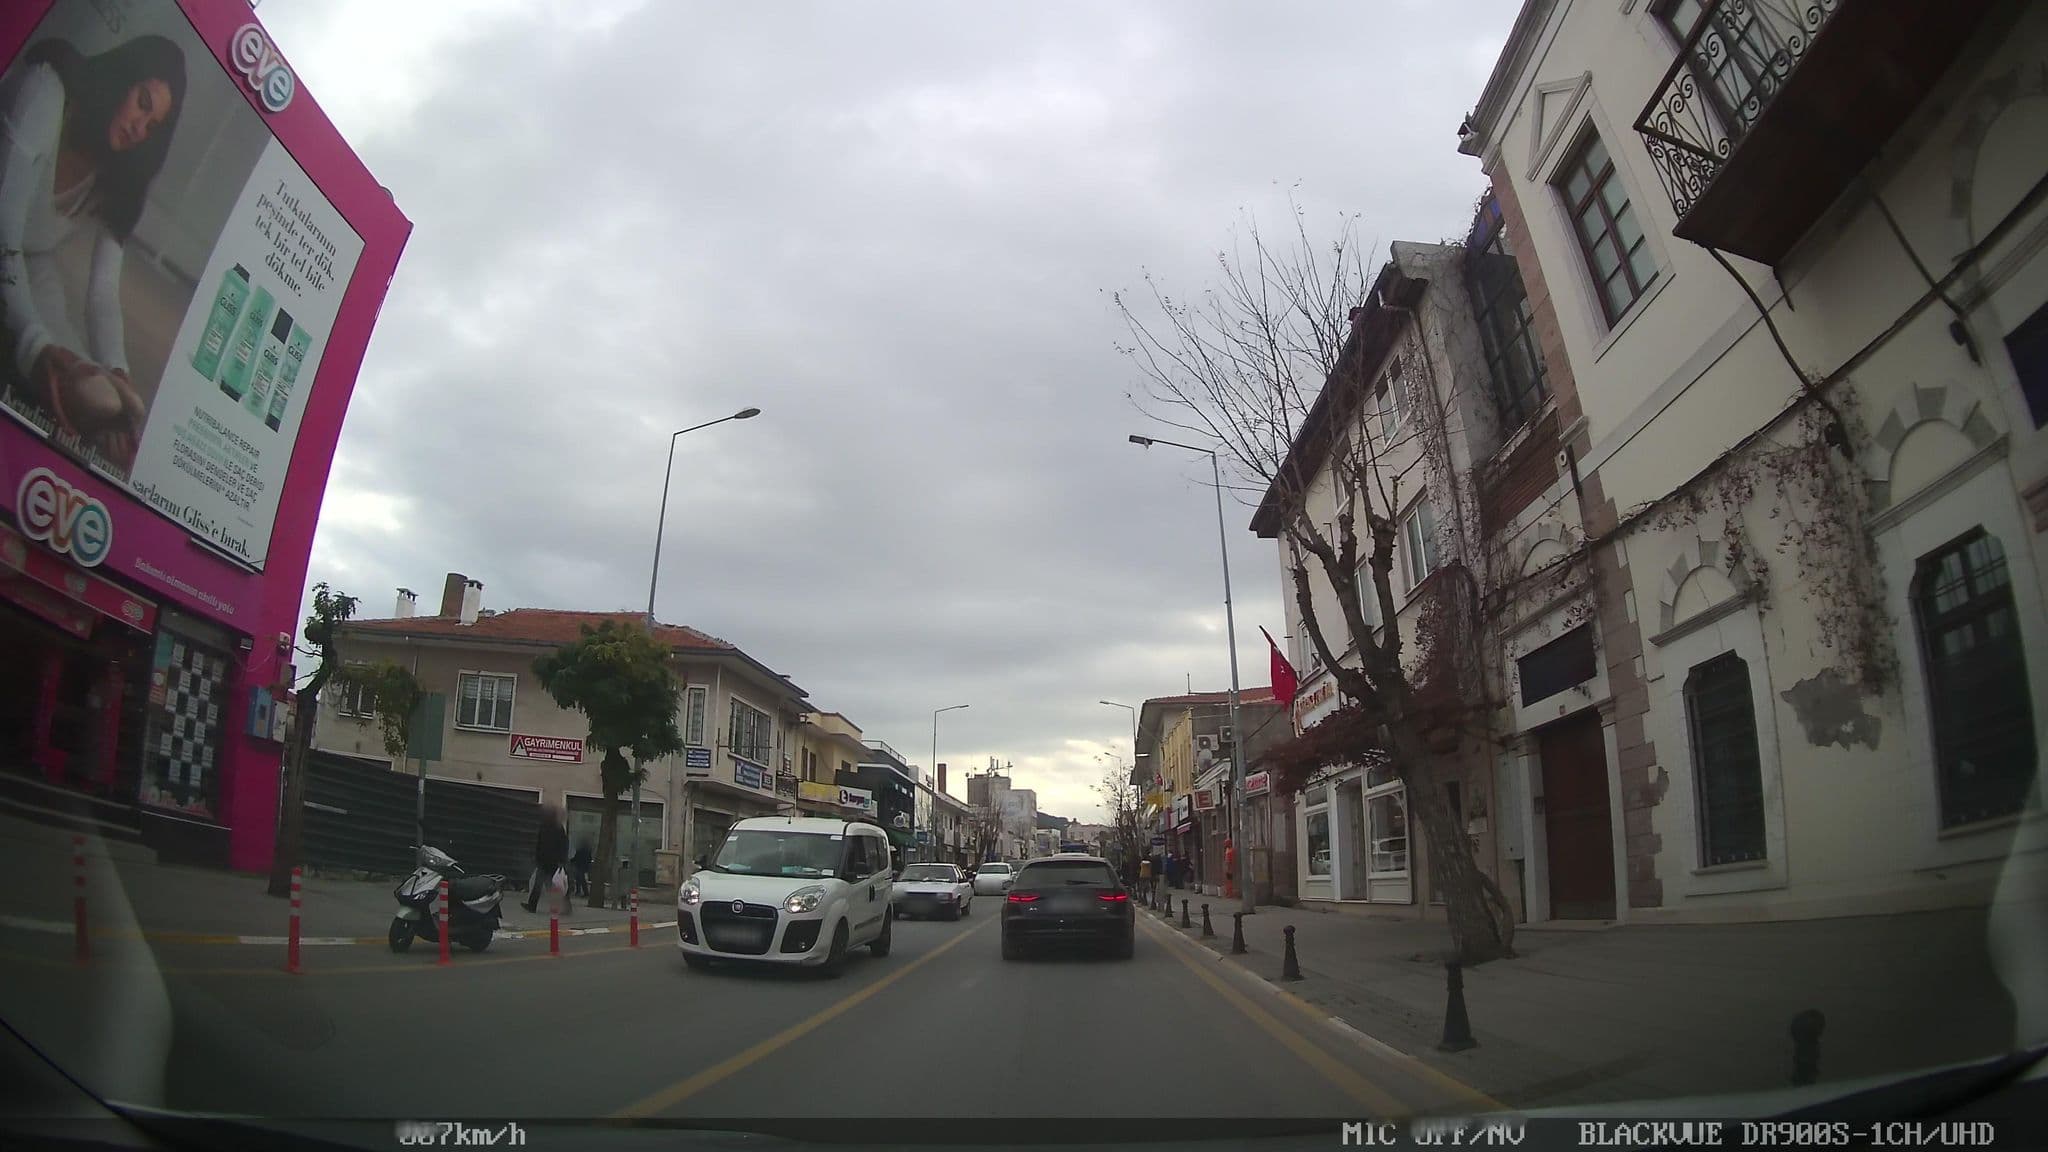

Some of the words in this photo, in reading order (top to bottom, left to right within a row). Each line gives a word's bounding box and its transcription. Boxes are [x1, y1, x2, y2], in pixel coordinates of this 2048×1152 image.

[236, 27, 292, 106] eve
[255, 214, 273, 240] tek
[273, 231, 291, 256] bir
[290, 252, 307, 273] tel
[305, 264, 326, 291] bile
[256, 193, 299, 237] peşinde
[299, 235, 315, 256] ter
[277, 182, 337, 257] Tutkularının
[264, 252, 302, 297] dökme.
[20, 473, 109, 562] eve
